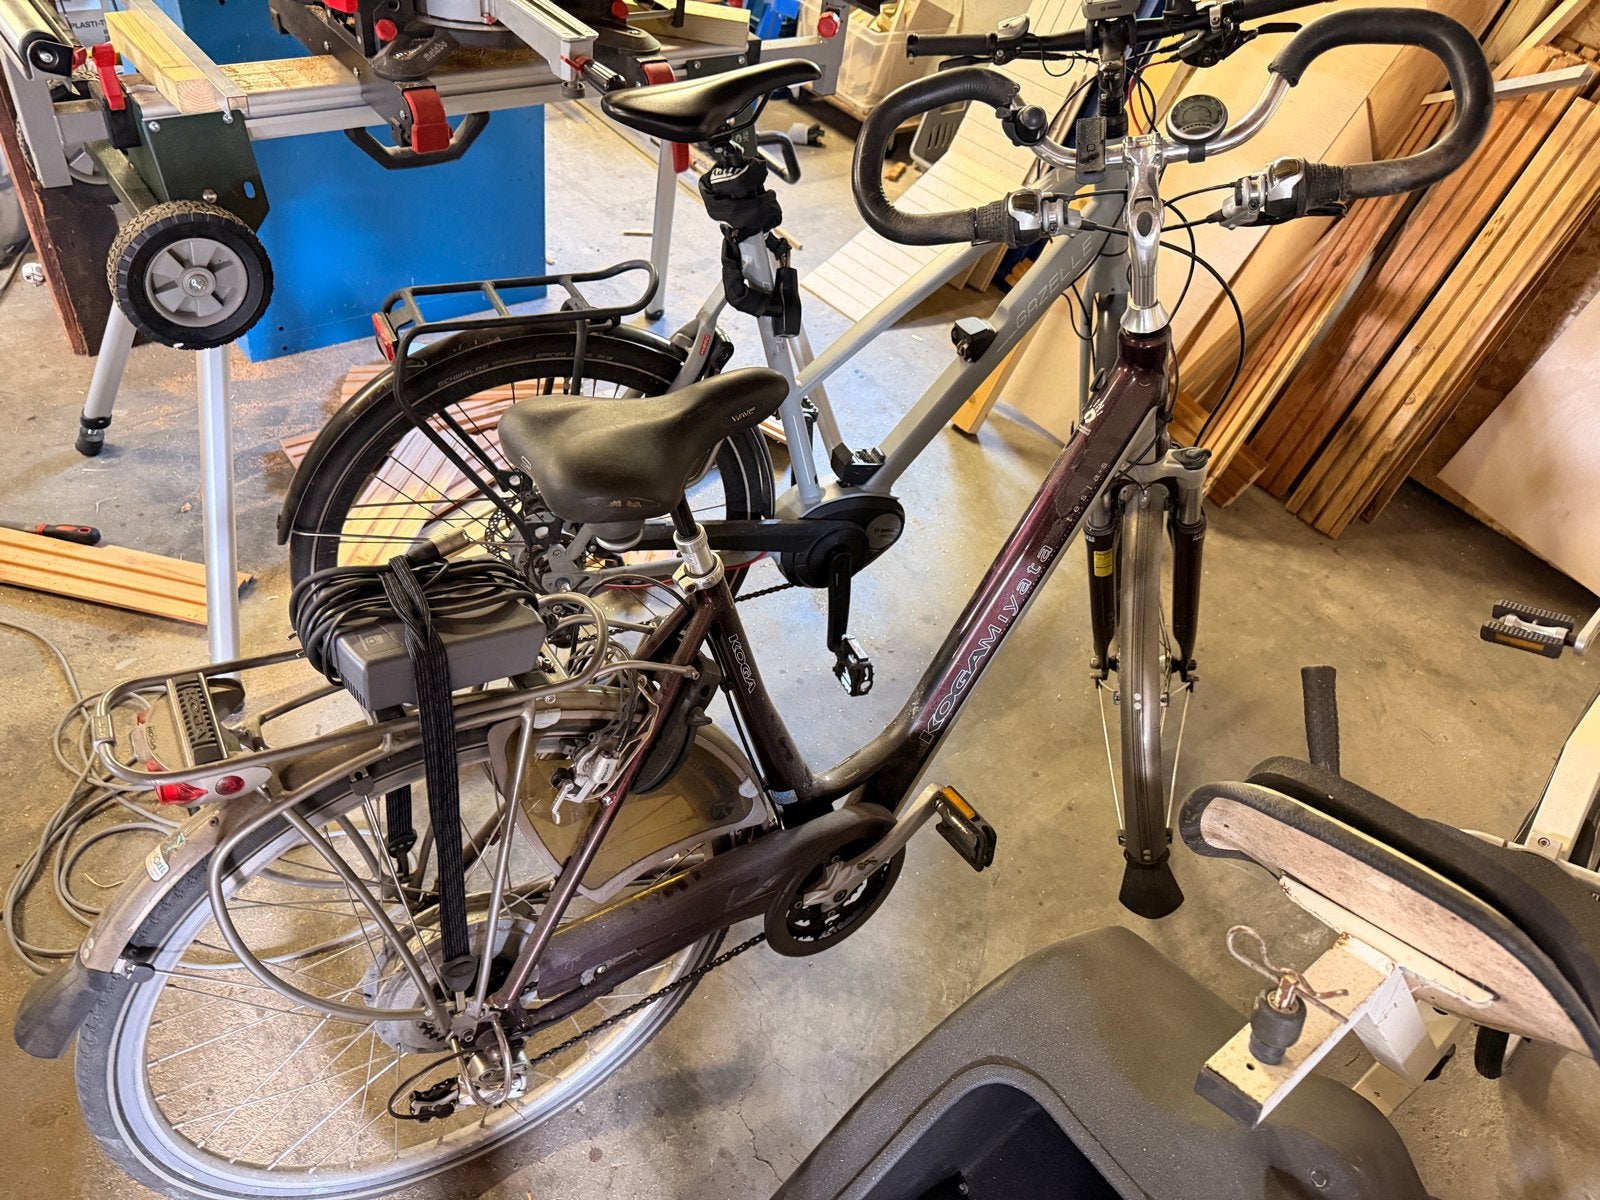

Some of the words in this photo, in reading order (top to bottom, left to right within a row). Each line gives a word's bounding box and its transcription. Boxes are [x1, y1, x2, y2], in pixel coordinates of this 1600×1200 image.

[71, 20, 107, 29] PLASTI-T
[423, 40, 448, 62] metabo
[1015, 235, 1093, 330] GAZELLE
[728, 633, 756, 694] KOGA
[185, 690, 208, 741] KOGA
